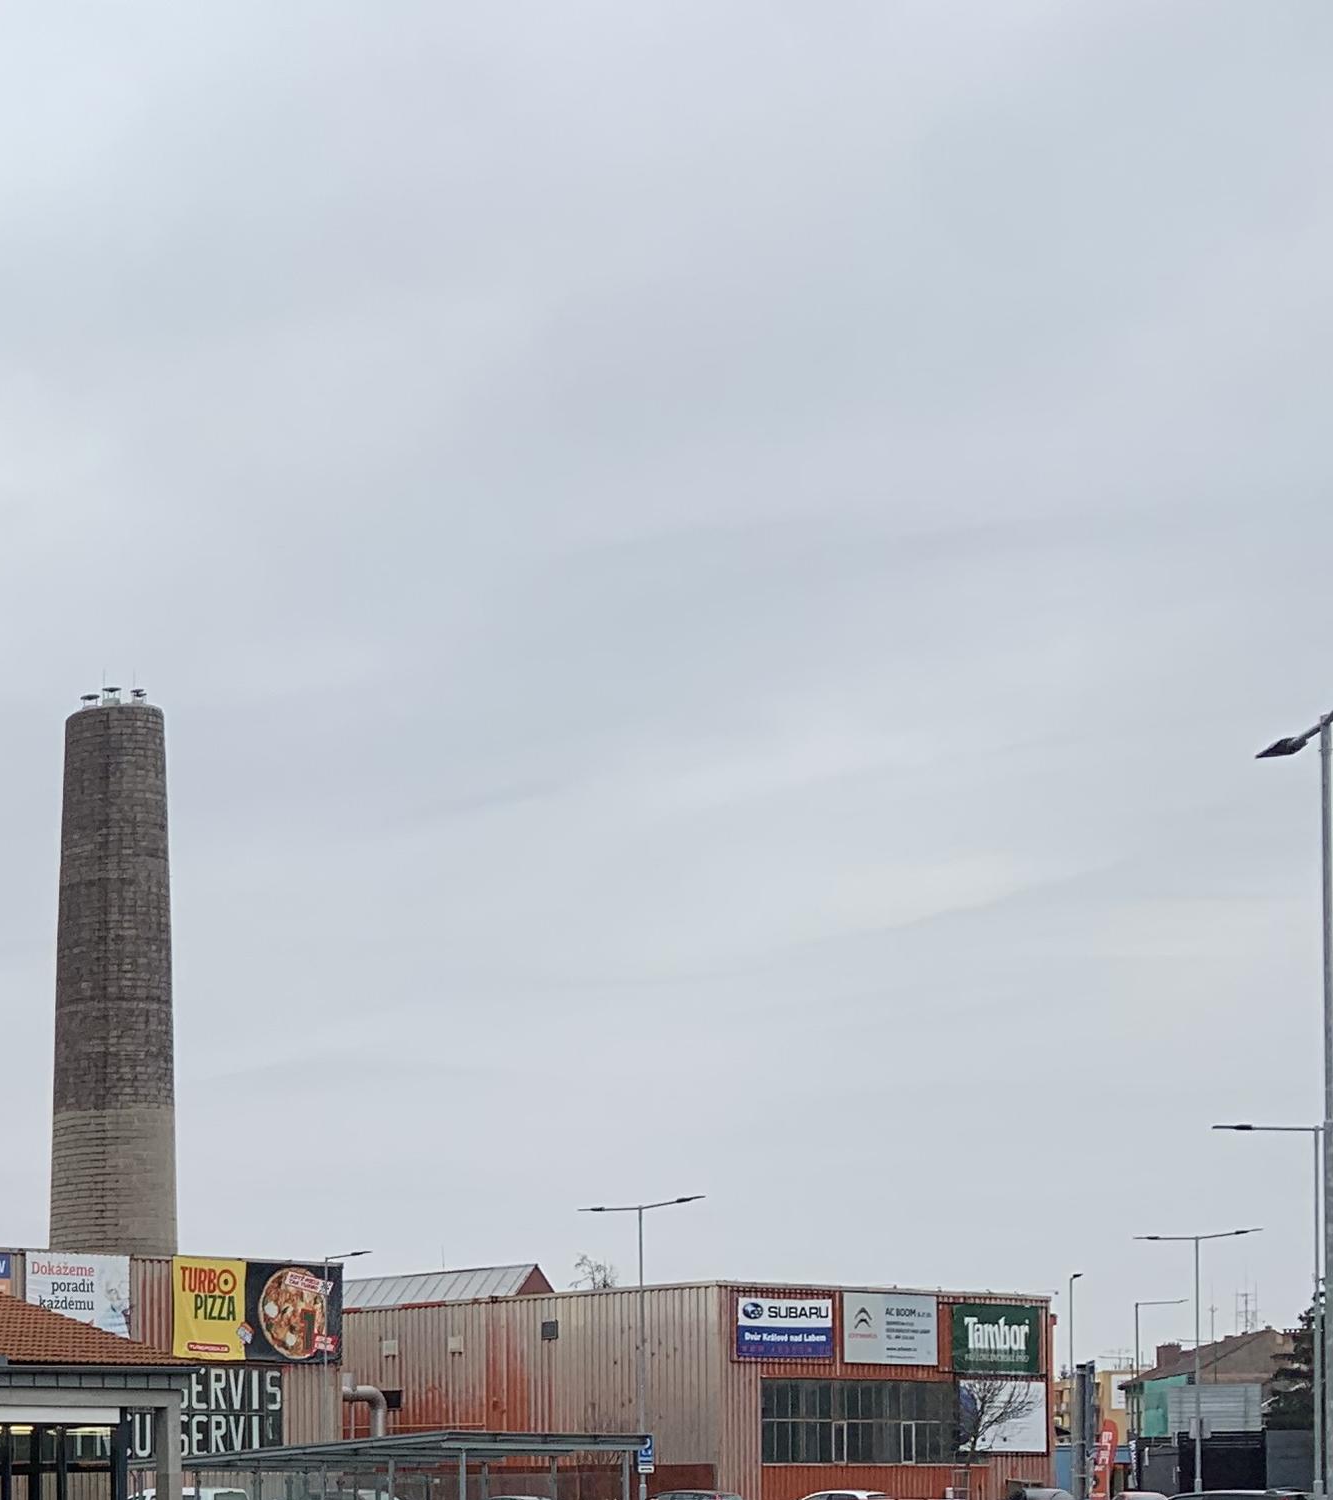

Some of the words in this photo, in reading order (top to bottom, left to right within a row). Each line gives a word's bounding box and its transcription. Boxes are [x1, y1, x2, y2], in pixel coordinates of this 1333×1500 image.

[31, 1260, 95, 1277] Dokážeme
[51, 1280, 95, 1295] poradit
[180, 1265, 237, 1296] TURBO
[38, 1294, 95, 1311] každému
[194, 1294, 237, 1322] PIZZA
[767, 1306, 829, 1319] SUBARU
[895, 1307, 917, 1317] BOOM
[744, 1331, 762, 1341] Dvůr
[762, 1331, 788, 1342] Králové
[789, 1333, 802, 1342] nad
[803, 1333, 827, 1342] Labem
